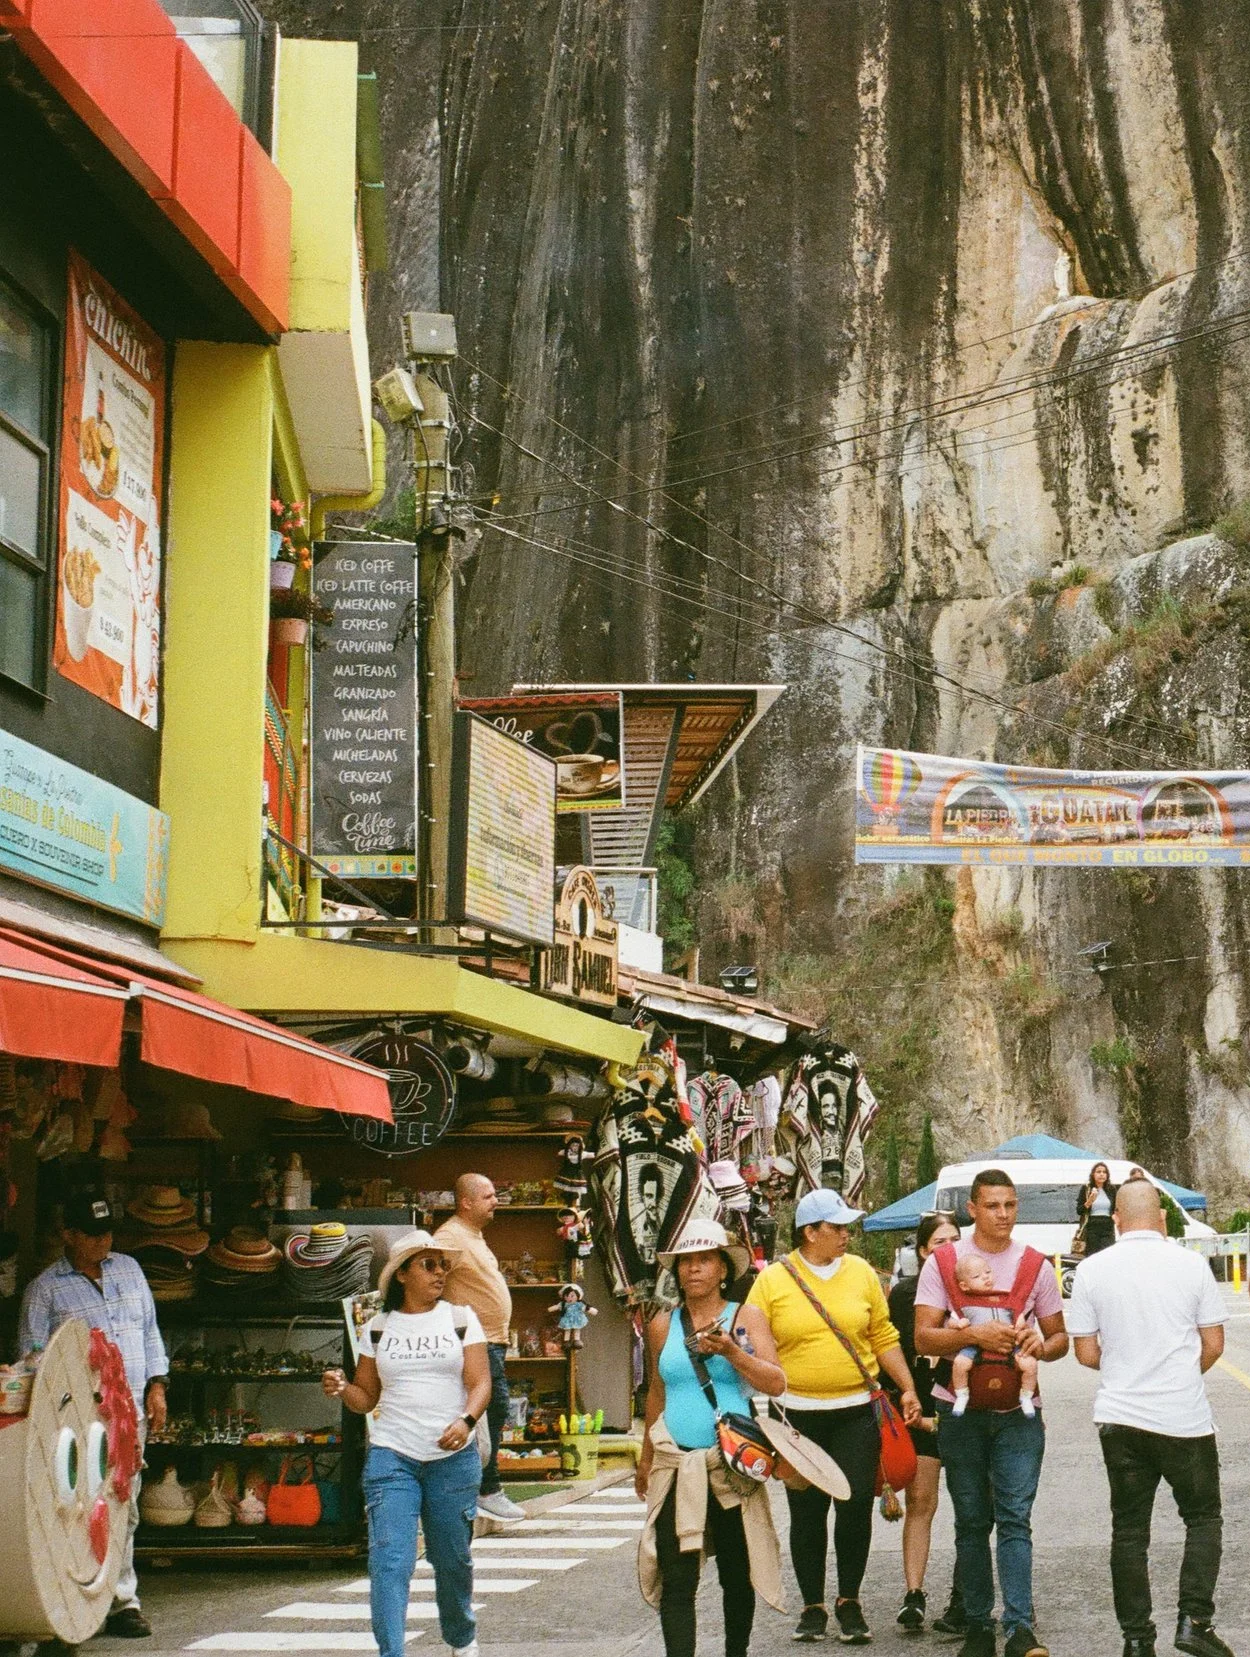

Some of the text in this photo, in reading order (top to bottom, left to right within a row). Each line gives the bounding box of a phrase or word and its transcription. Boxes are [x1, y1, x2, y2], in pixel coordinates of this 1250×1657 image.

[335, 559, 395, 573] ICED COFFE
[317, 580, 414, 594] ICED LATTE COFFE
[334, 598, 396, 612] AMERICANO
[342, 618, 388, 631] EXPRESO
[336, 639, 394, 653] CAPUCHINO
[333, 664, 397, 678] MALTEADAS
[334, 686, 397, 700] GRANIZADO
[324, 727, 407, 742] VINO CALIENTE
[332, 748, 398, 762] MICHELADAS
[339, 770, 393, 784] CERVEZAS
[350, 790, 382, 805] SODAS
[342, 812, 396, 836] Coffee
[346, 831, 395, 852] Time
[1112, 849, 1139, 864] EN
[354, 1118, 434, 1146] COFFEE
[384, 1334, 455, 1352] PARIS
[431, 1351, 446, 1359] Vie
